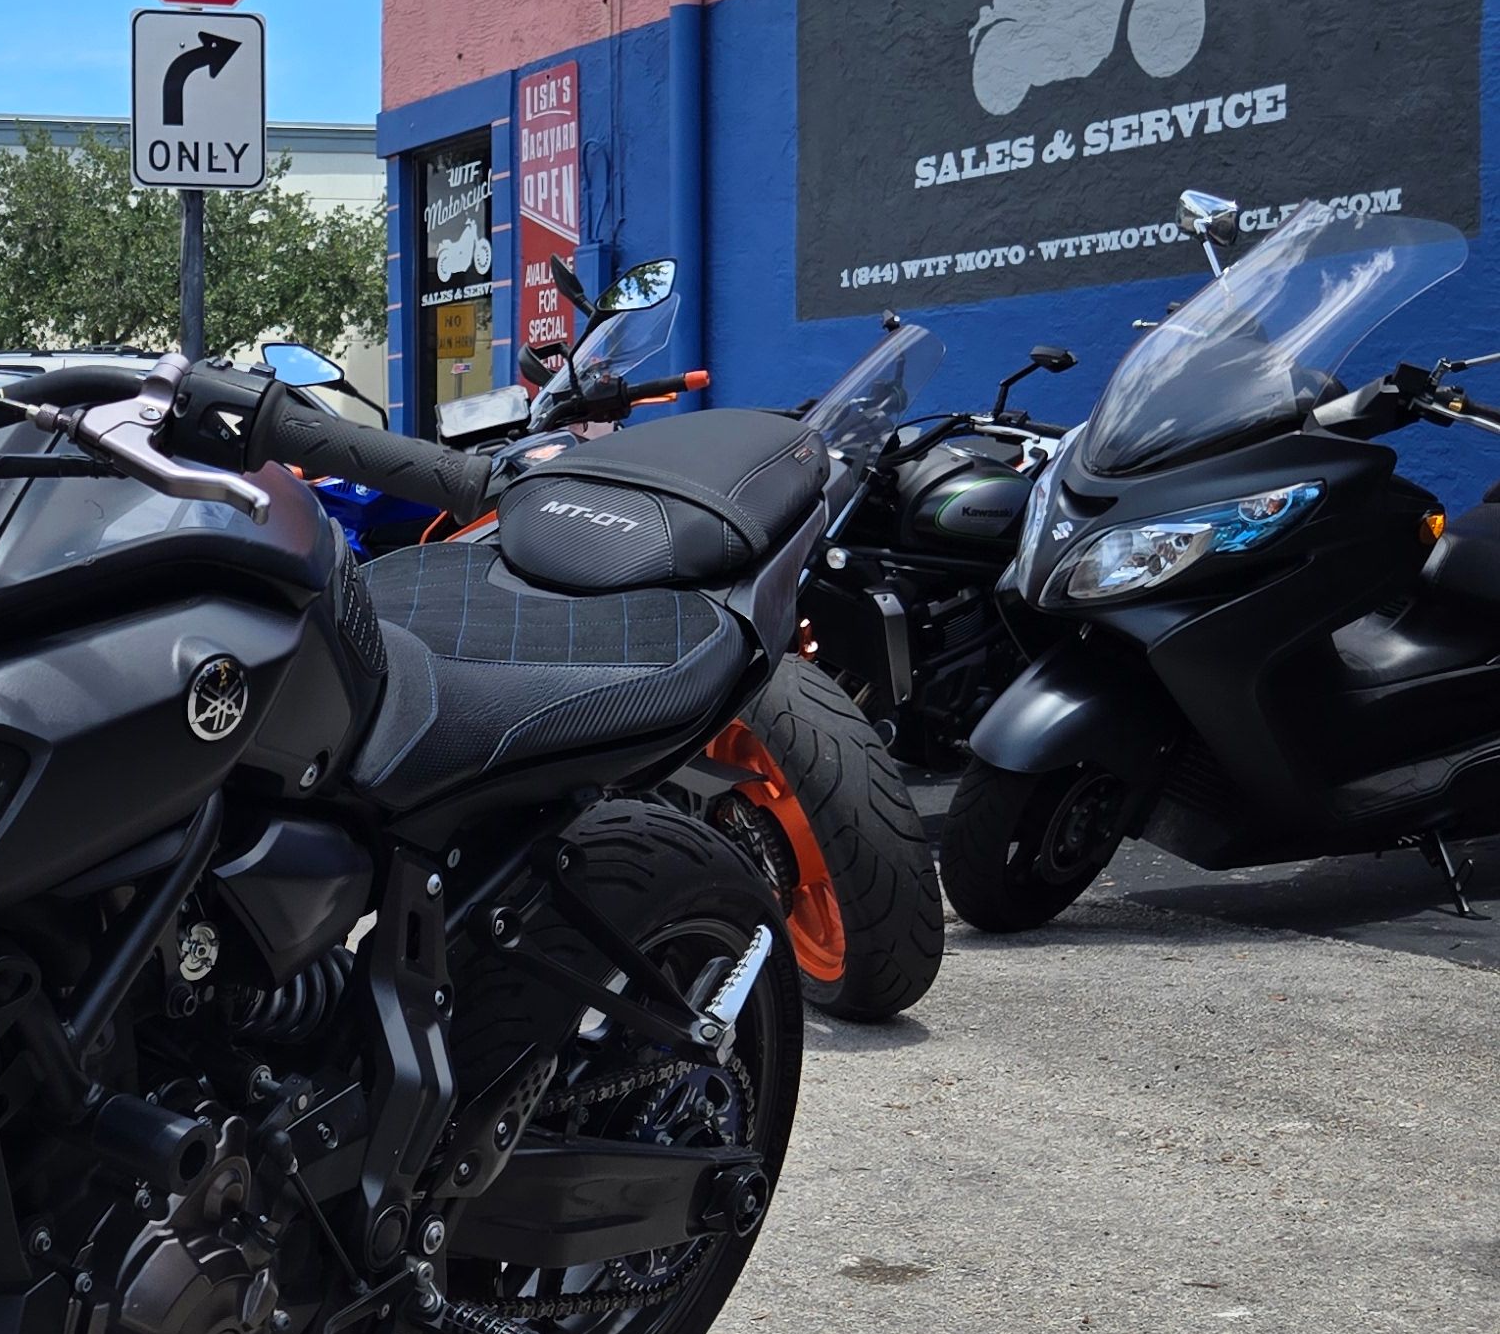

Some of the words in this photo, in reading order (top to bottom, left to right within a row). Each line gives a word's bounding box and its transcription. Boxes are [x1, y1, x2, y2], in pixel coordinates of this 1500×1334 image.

[914, 135, 1034, 189] SALES
[1042, 130, 1075, 163] &
[1083, 83, 1286, 157] SERVICE
[148, 139, 250, 173] ONLY
[446, 160, 482, 187] WTF
[424, 168, 493, 232] Motorcycl
[523, 164, 575, 228] OPEN
[525, 257, 574, 287] AVAILAE
[901, 255, 951, 279] WTF
[955, 245, 1025, 273] MOTO
[421, 285, 453, 307] SALES
[463, 282, 493, 299] SERV
[538, 288, 558, 314] FOR
[528, 315, 568, 343] SPECIAL
[540, 500, 639, 533] MT-07
